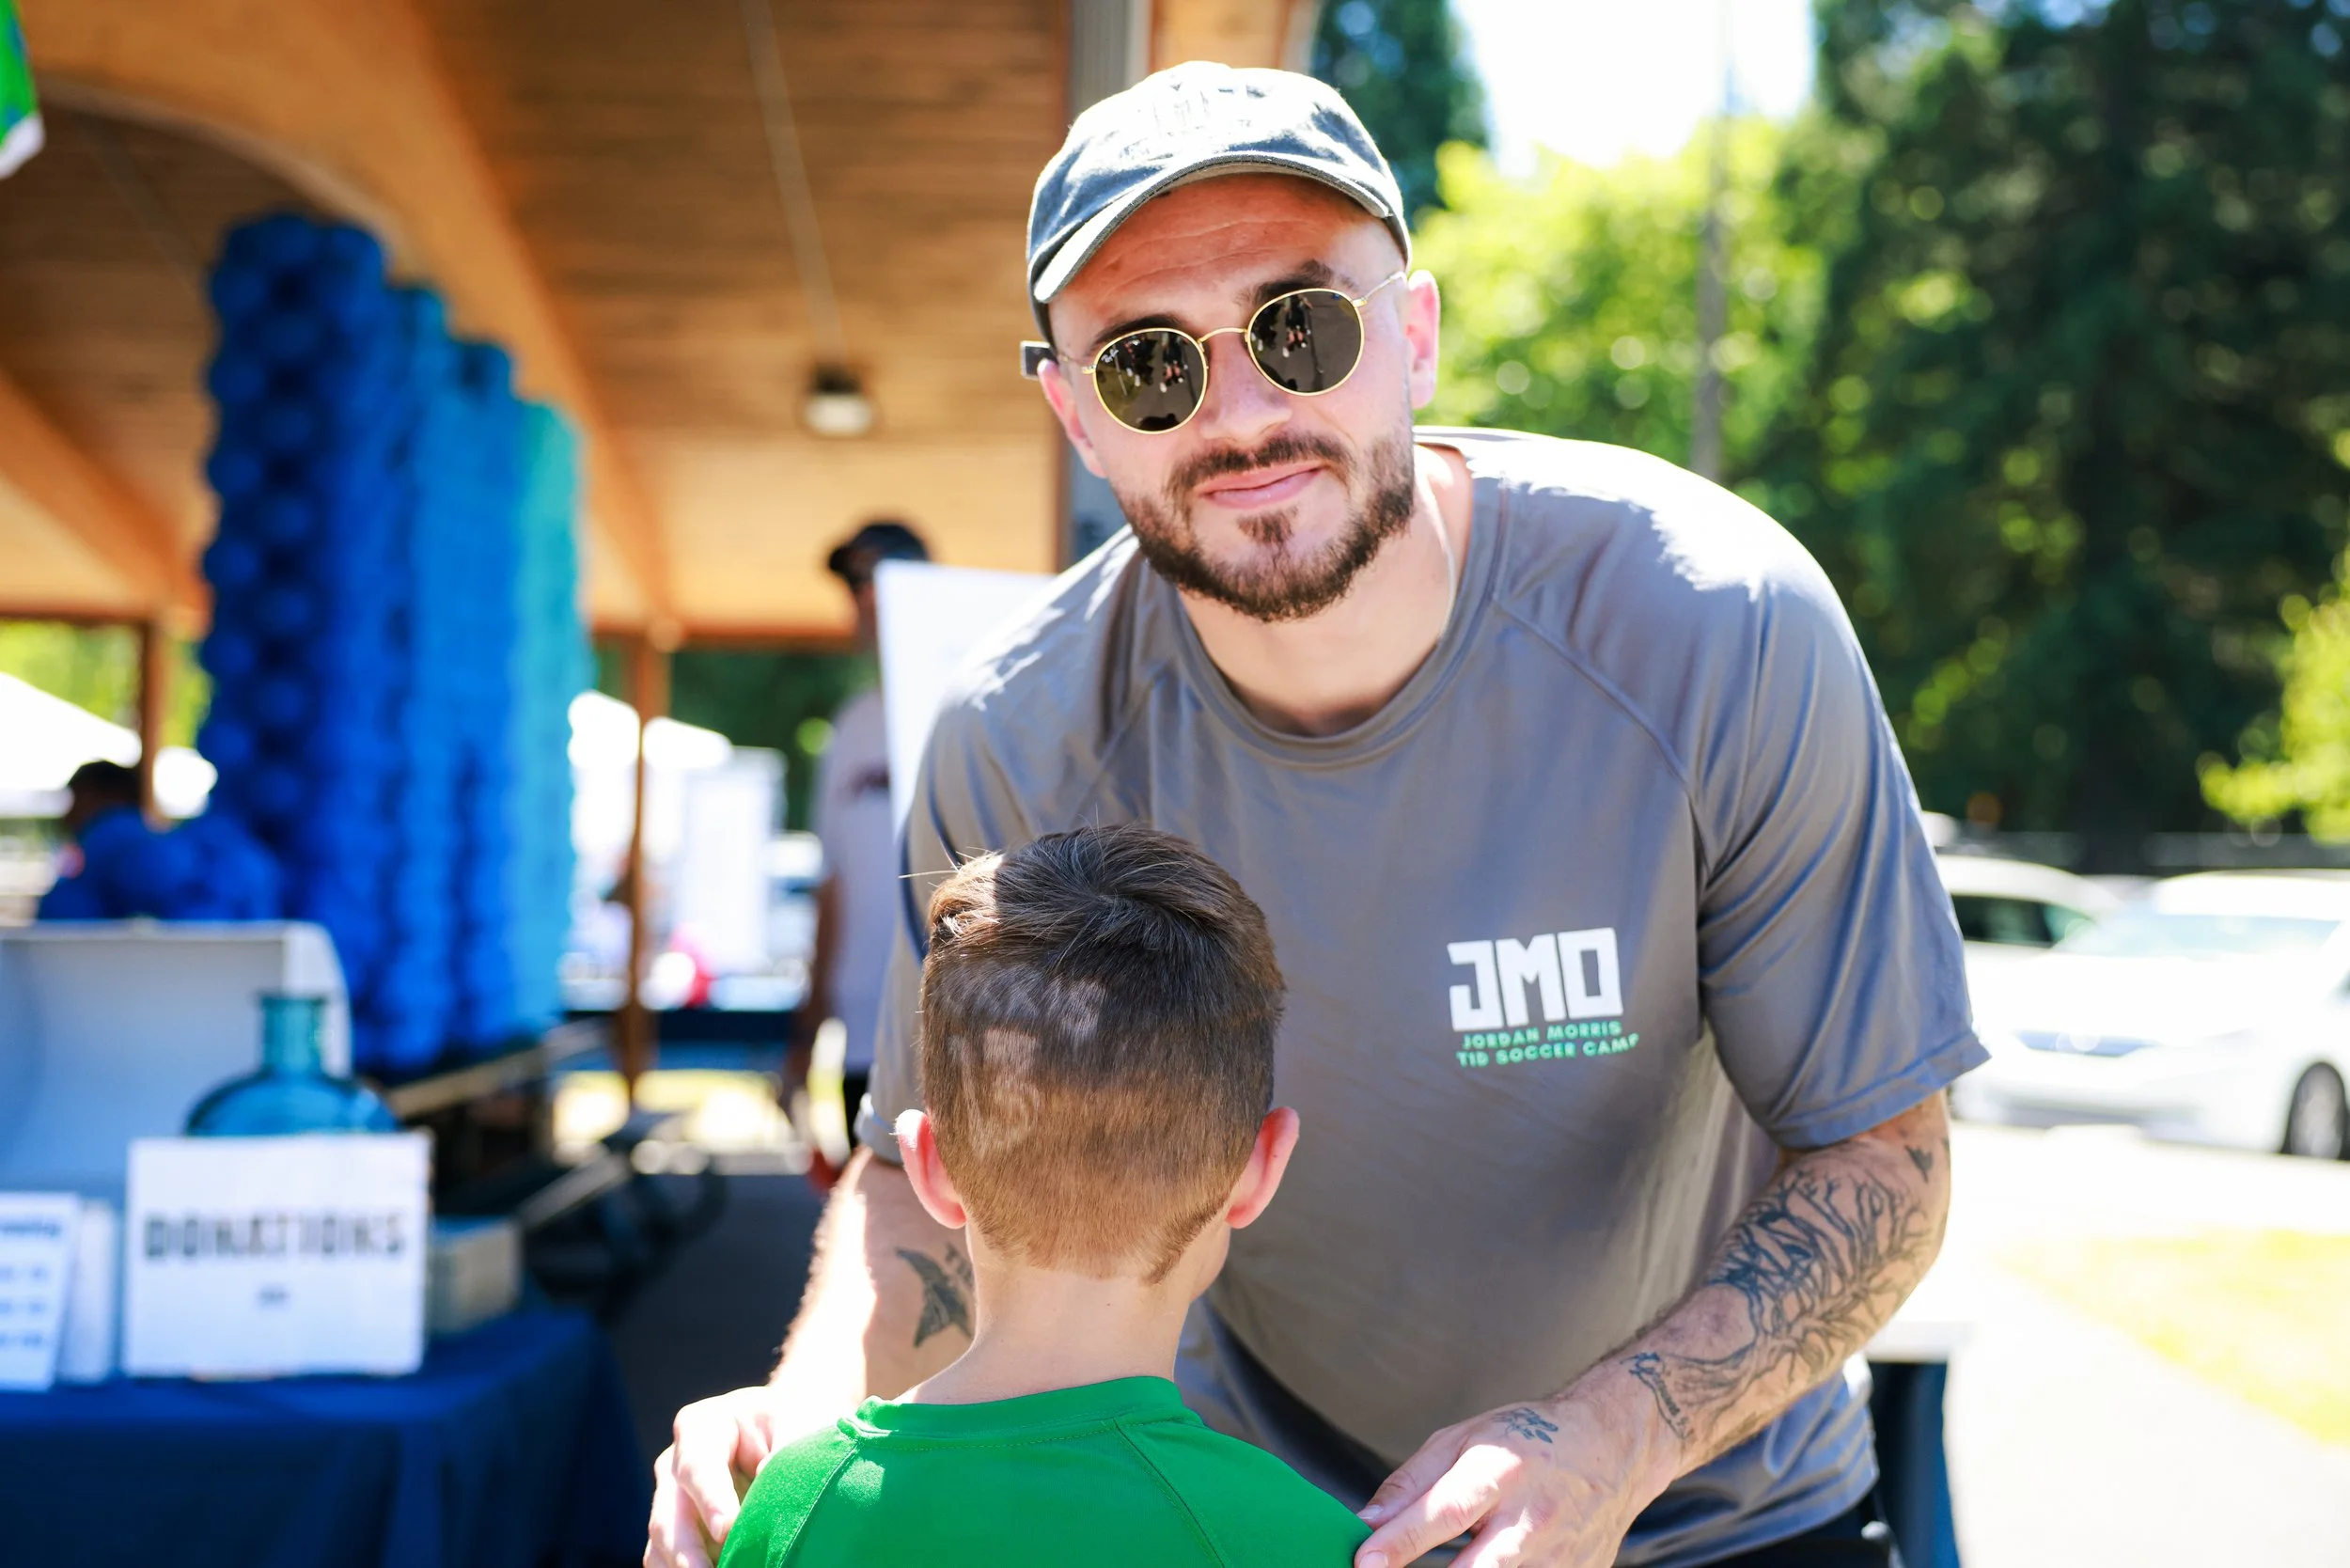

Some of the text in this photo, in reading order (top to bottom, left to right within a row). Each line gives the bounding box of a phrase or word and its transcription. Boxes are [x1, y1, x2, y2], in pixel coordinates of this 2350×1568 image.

[1447, 927, 1623, 1032] JMO
[1462, 1020, 1622, 1050] JORDAN MORRIS
[1495, 1042, 1576, 1065] SOCCER
[1582, 1032, 1639, 1057] CAMP
[145, 1215, 405, 1258] DONATIONS
